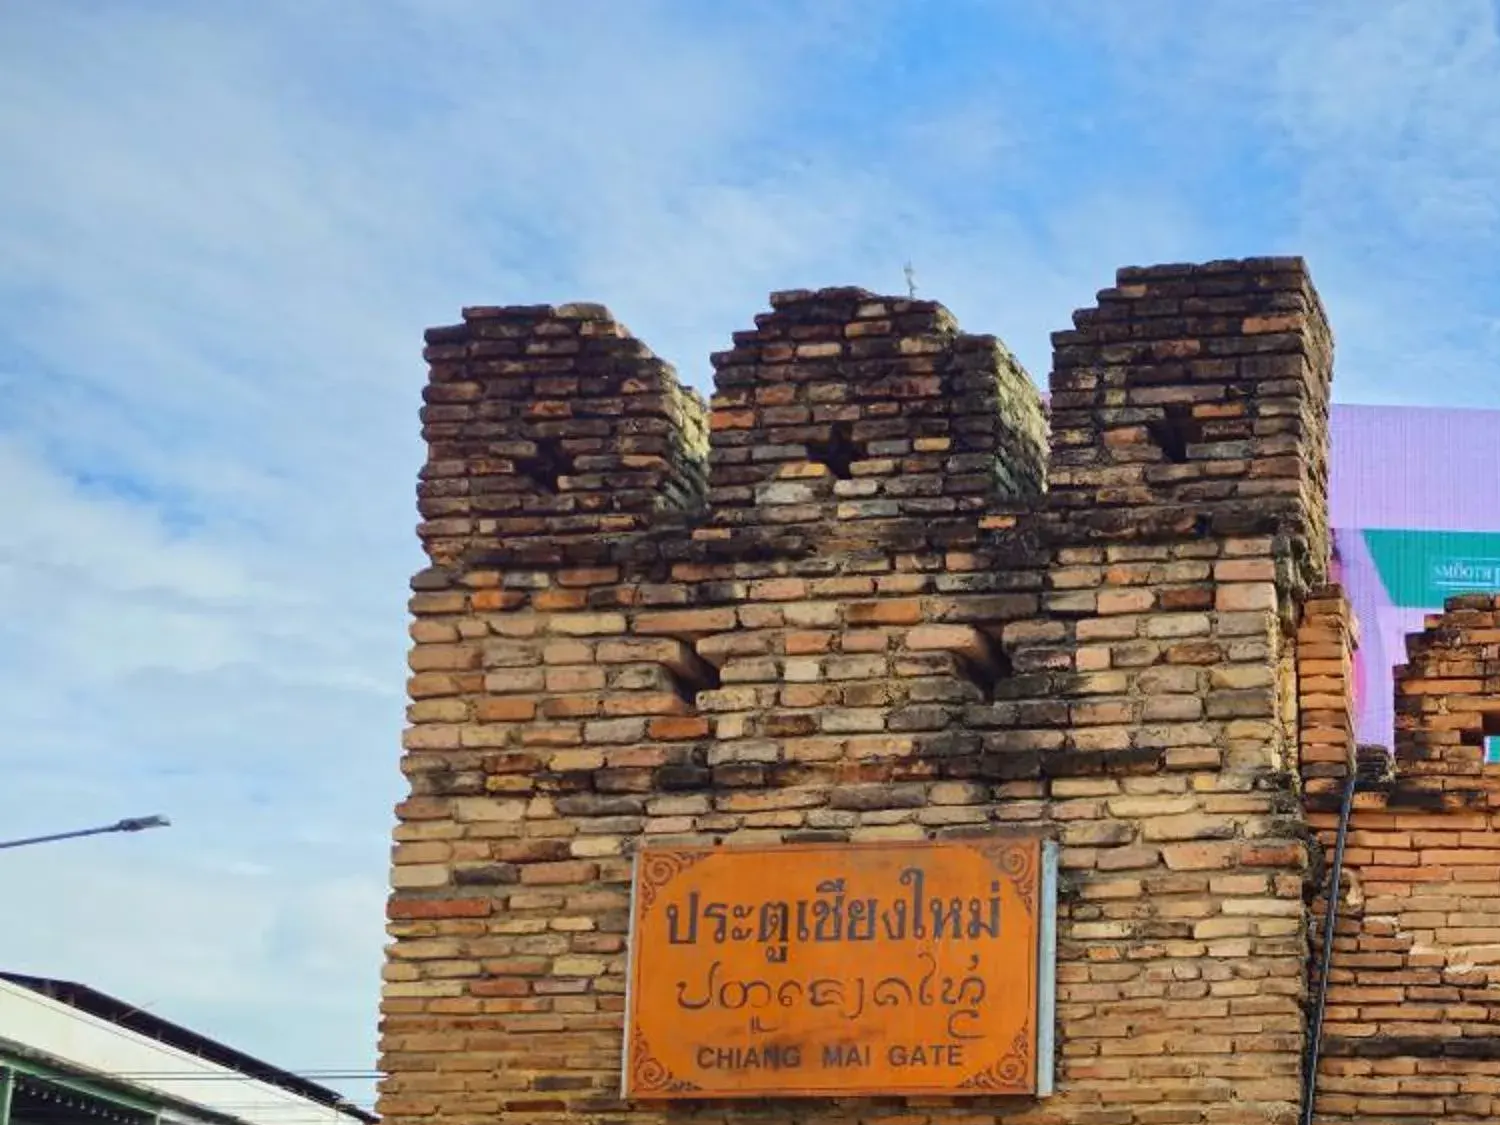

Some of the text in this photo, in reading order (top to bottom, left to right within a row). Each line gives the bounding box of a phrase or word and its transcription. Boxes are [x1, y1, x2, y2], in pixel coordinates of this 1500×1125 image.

[666, 867, 1001, 964] ประตูเชียงใหม่
[696, 1043, 963, 1070] CHIANG MAI GATE
